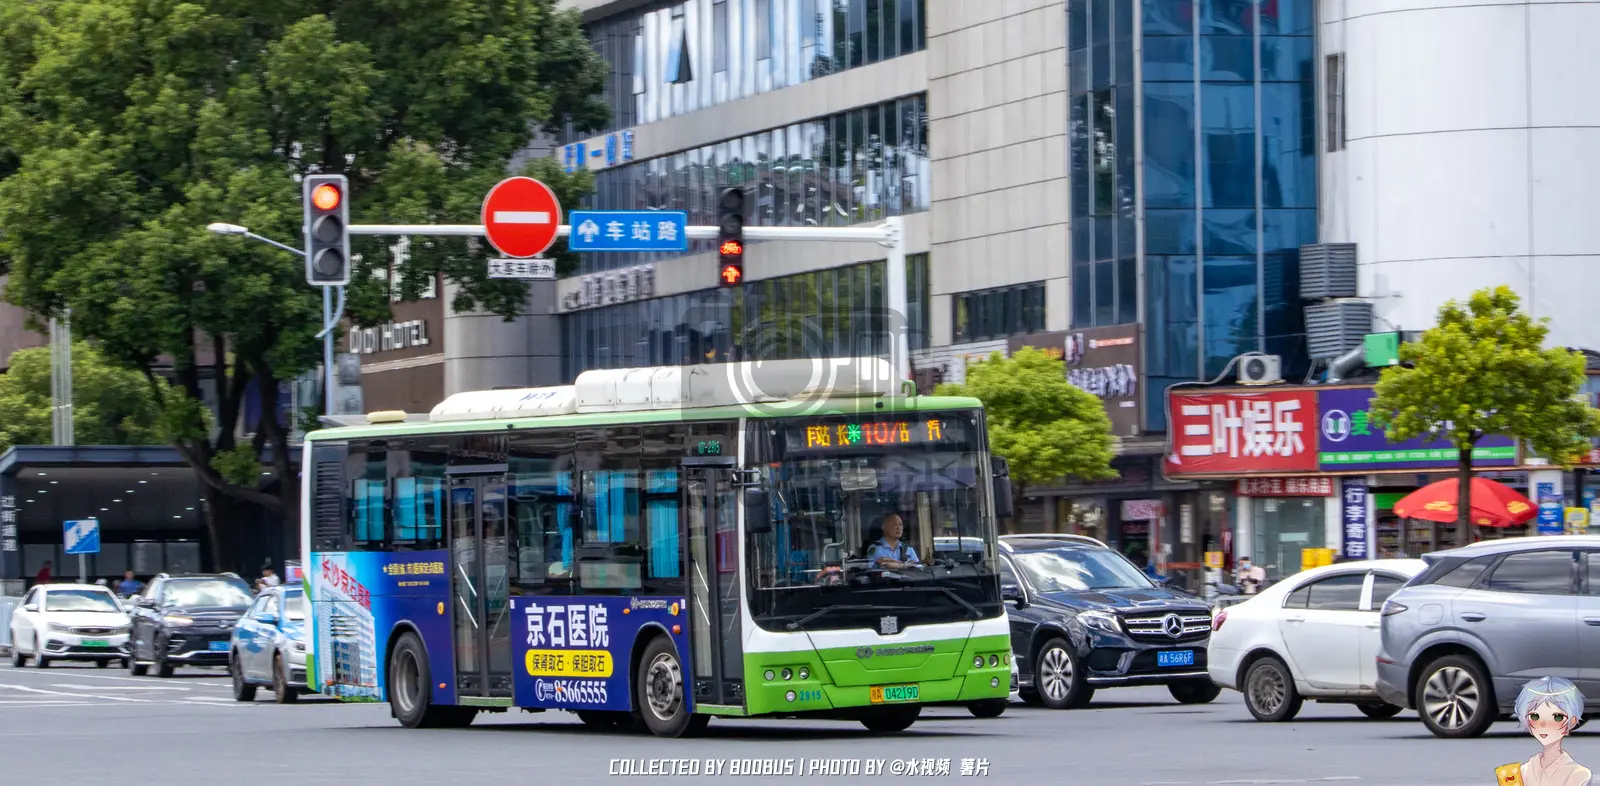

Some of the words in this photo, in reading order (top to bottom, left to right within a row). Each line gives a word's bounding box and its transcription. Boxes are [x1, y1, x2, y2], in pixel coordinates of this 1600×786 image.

[605, 220, 679, 242] 车站路
[382, 319, 430, 352] HOTEL
[1180, 399, 1305, 460] 三叶娱乐
[1344, 487, 1366, 557] 行李寄存
[524, 602, 610, 648] 京石医院
[554, 679, 608, 704] 85665555
[885, 686, 919, 700] 04219D
